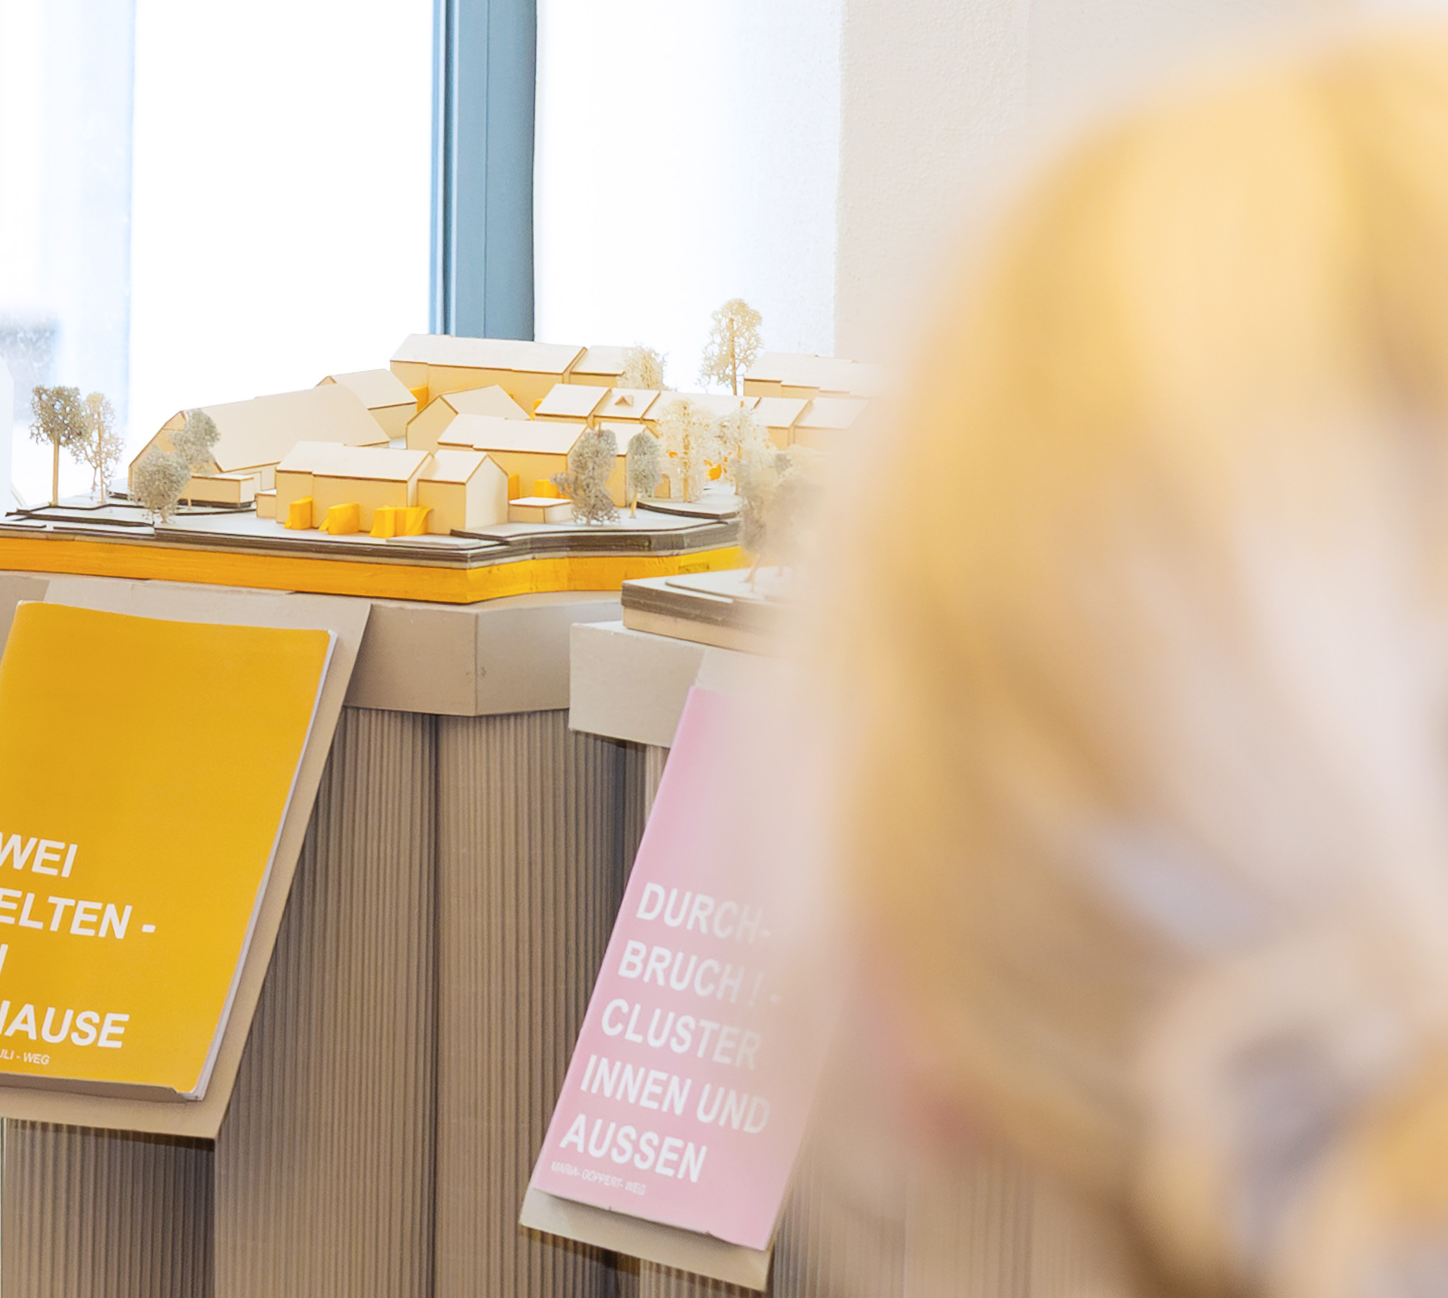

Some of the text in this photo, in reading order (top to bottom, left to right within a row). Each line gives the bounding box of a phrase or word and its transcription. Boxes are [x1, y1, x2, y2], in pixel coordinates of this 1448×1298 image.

[618, 939, 745, 1003] BRUCH
[23, 1051, 51, 1066] WEG
[601, 999, 763, 1072] CLUSTER
[580, 1055, 773, 1134] INNEN UND
[559, 1113, 708, 1183] AUSSEN
[625, 1181, 647, 1196] WEG
